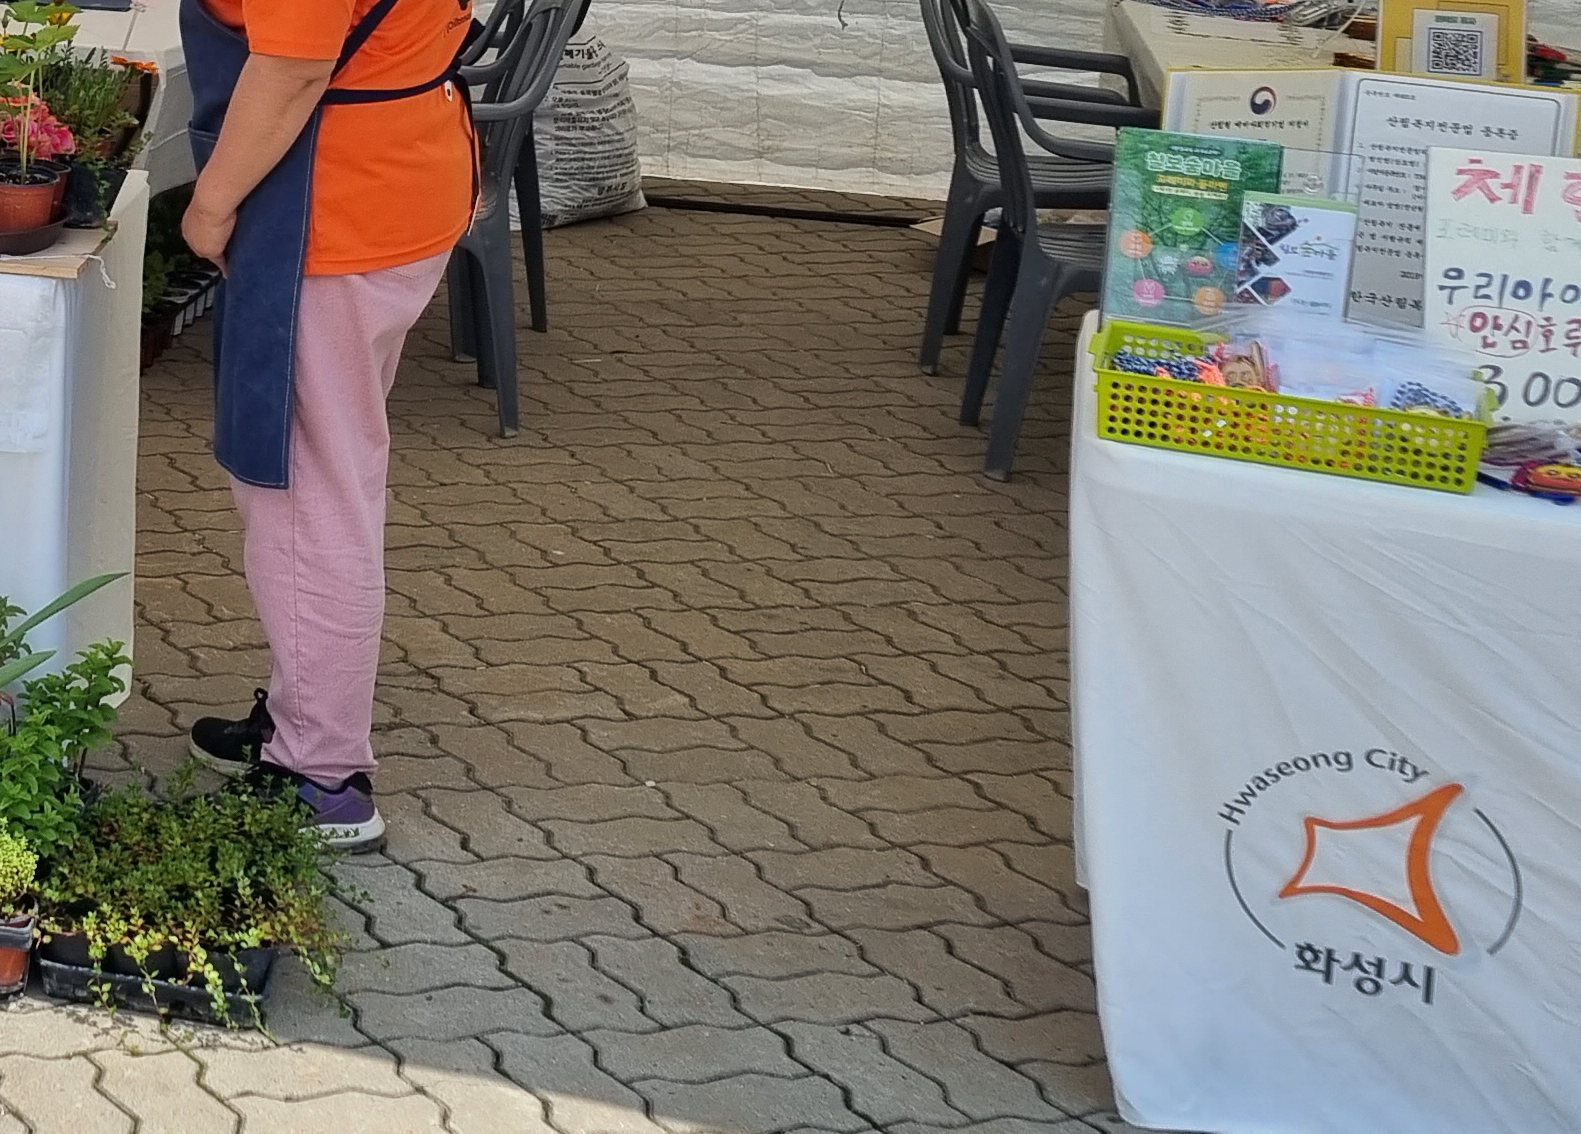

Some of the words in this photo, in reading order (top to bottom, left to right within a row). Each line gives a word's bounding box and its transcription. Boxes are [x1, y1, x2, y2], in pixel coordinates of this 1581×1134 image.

[1217, 749, 1354, 826] Hwaseong
[1363, 748, 1432, 784] City
[1294, 941, 1437, 1005] 화성시
